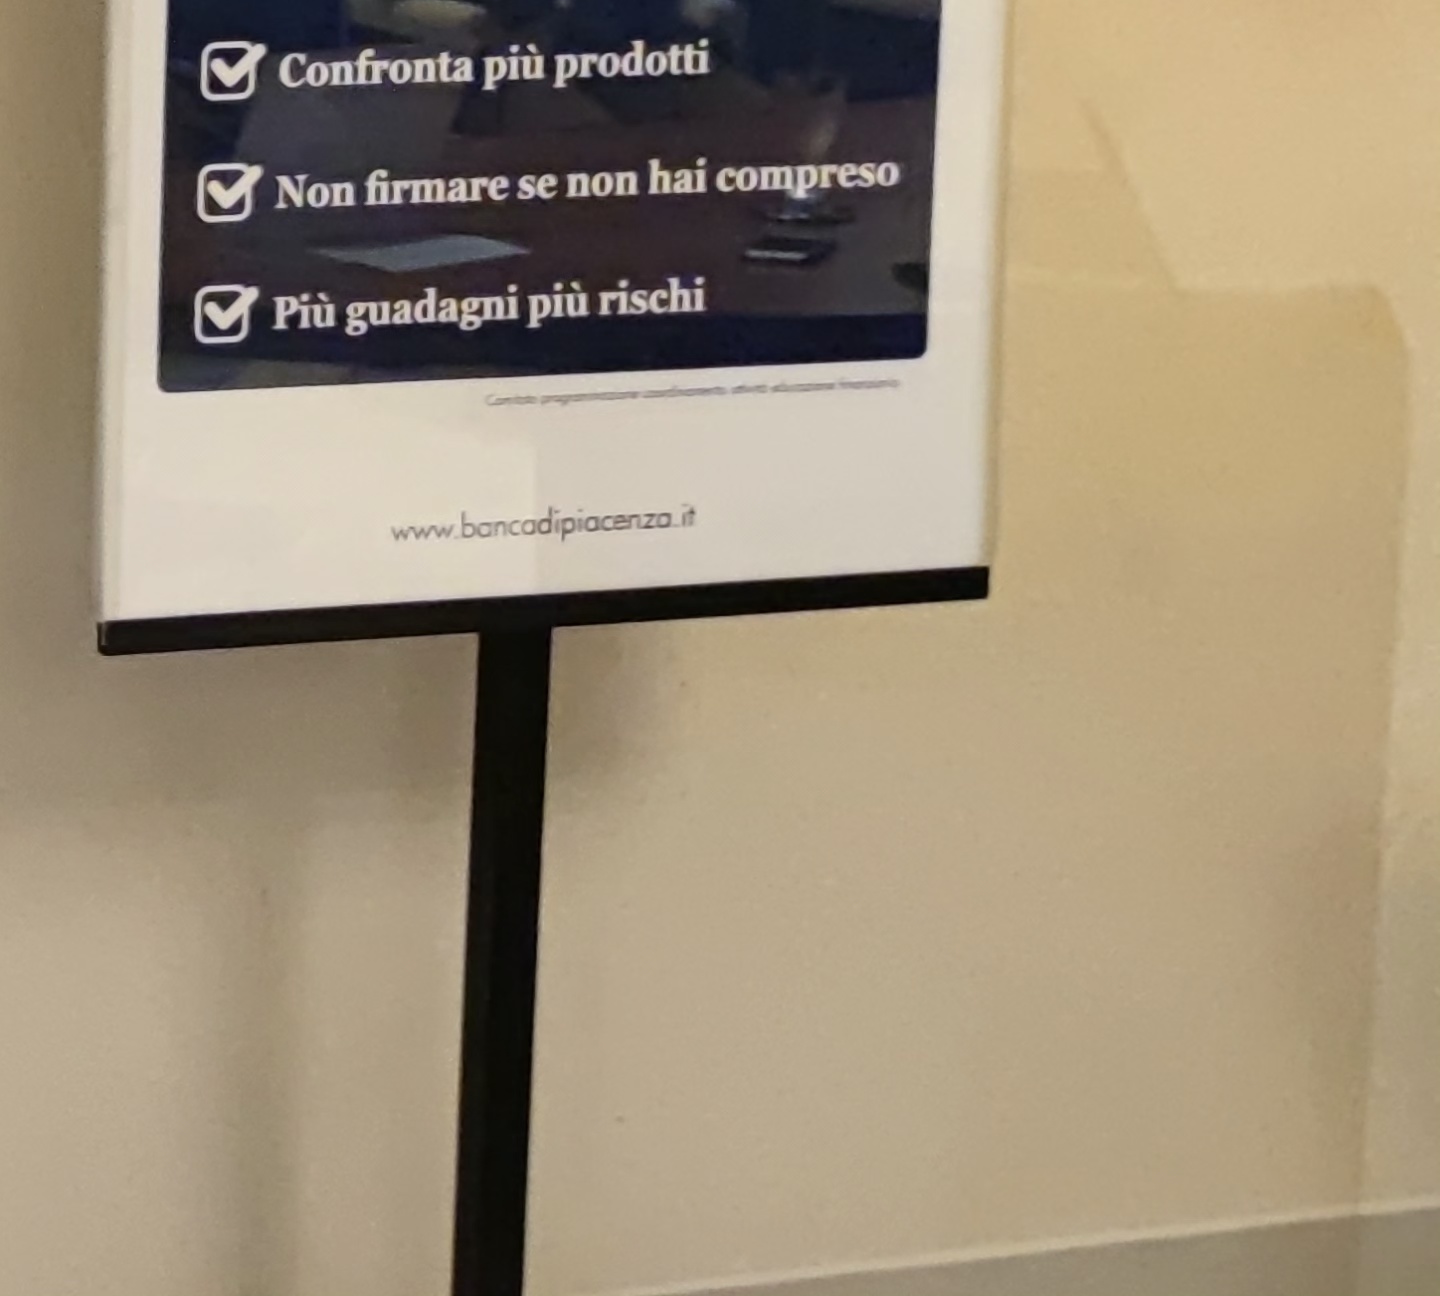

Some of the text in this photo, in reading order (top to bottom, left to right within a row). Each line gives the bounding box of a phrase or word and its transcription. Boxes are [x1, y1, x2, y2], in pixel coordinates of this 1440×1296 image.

[278, 37, 711, 92] Confronta più prodotti
[275, 156, 901, 209] Non firmare se non hai compreso
[272, 275, 707, 337] Più guadagni più rischi
[391, 503, 697, 542] www.bancadipiacenza.it
